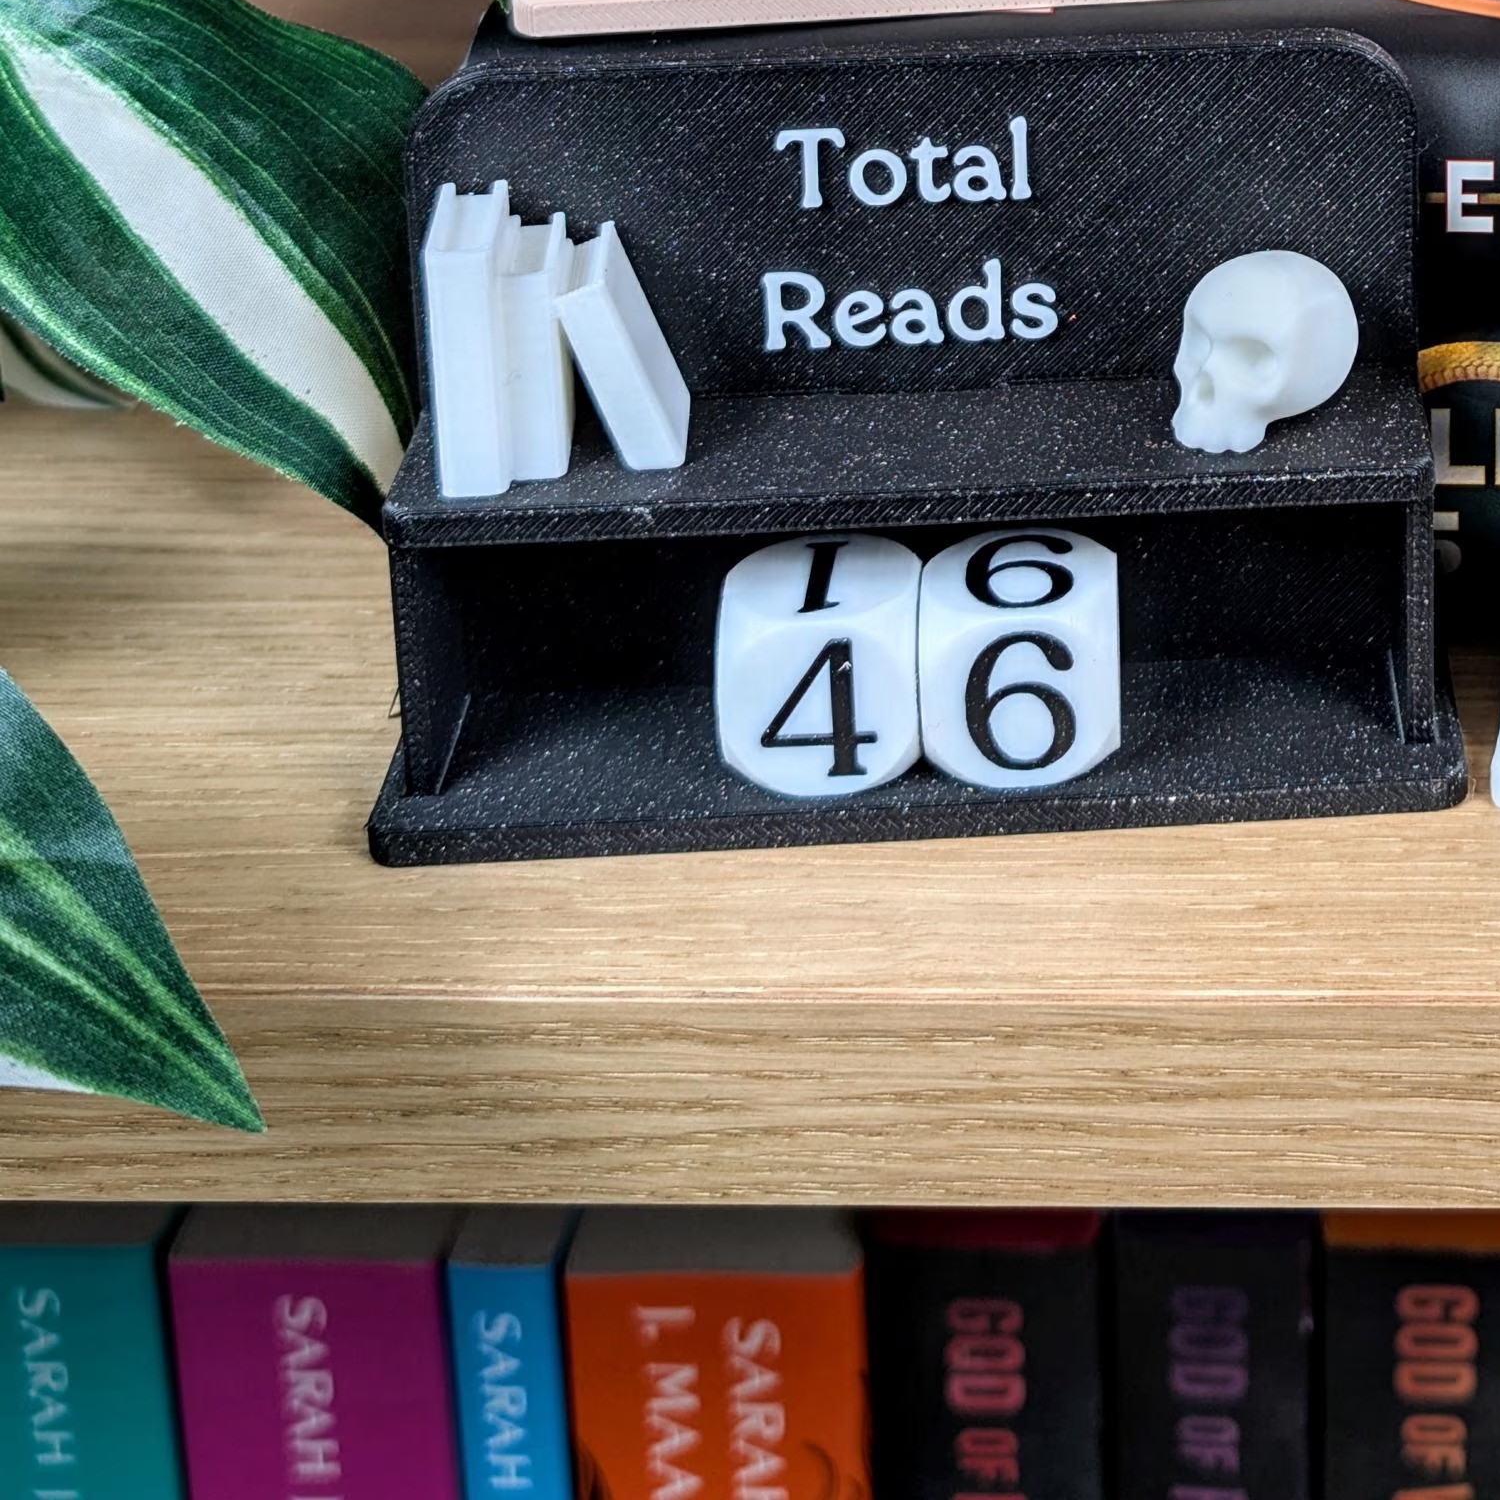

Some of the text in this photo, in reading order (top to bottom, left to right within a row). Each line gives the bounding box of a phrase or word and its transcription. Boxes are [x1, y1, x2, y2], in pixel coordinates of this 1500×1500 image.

[774, 115, 1033, 209] Total
[760, 257, 1059, 351] Reads
[18, 1286, 78, 1467] SARAH
[273, 1293, 343, 1483] SARAH
[472, 1310, 535, 1492] SARAH
[943, 1297, 1026, 1414] GOD
[1168, 1285, 1250, 1402] GOD
[1393, 1283, 1479, 1402] GOD
[955, 1426, 1020, 1483] OF
[1175, 1414, 1242, 1473] OF
[1401, 1413, 1467, 1475] OF
